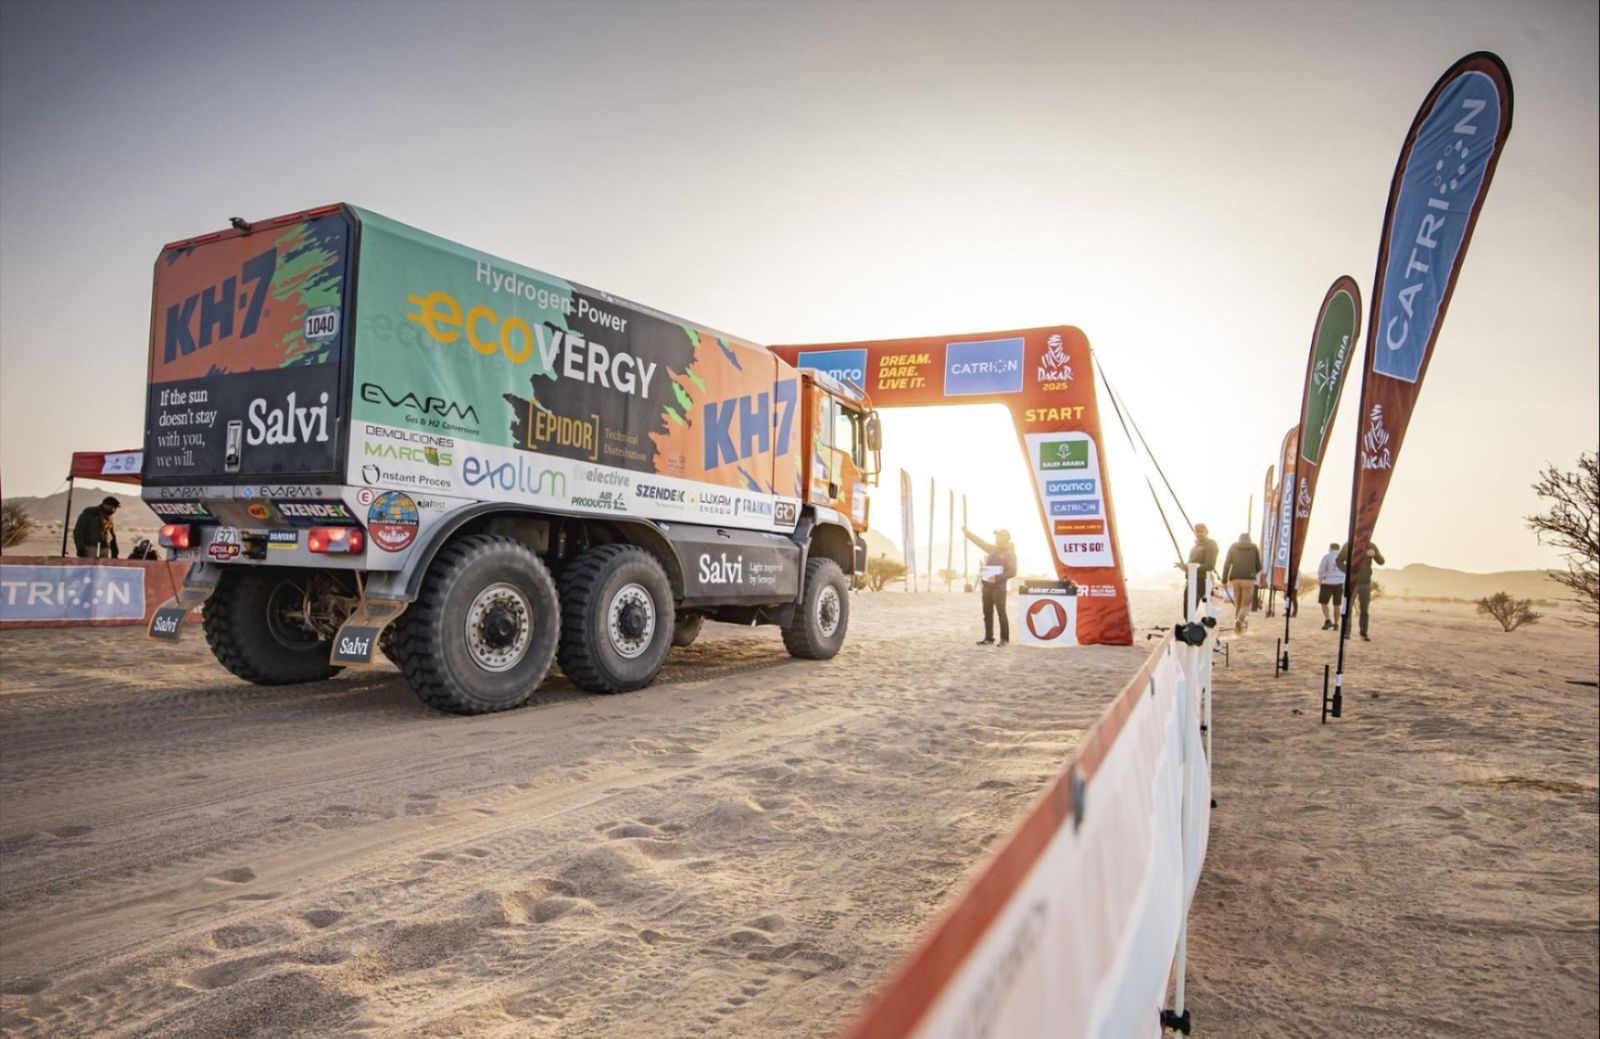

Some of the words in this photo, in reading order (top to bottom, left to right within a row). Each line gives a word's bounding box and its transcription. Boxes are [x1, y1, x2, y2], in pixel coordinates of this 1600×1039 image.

[1387, 97, 1488, 351] CATRION
[475, 260, 573, 315] Hydrogen
[578, 298, 628, 333] Power
[307, 314, 335, 336] 1040
[880, 352, 931, 367] DREAM.
[950, 359, 1018, 375] CATRION
[879, 365, 919, 378] DARE.
[1036, 366, 1074, 382] DAKAR
[878, 377, 908, 390] LIVE
[910, 376, 926, 388] IT.
[1042, 382, 1069, 391] 2025
[160, 390, 170, 407] If
[170, 389, 187, 404] the
[188, 389, 208, 403] sun
[159, 408, 194, 427] doesn't
[194, 410, 217, 427] stay
[246, 391, 329, 446] Salvi
[1025, 405, 1085, 422] START
[405, 414, 419, 425] Gas
[419, 416, 426, 425] &
[428, 418, 440, 428] H2
[442, 420, 480, 436] Conversions
[158, 431, 180, 447] with
[182, 432, 206, 451] you,
[365, 424, 455, 448] DEMOLICIONES
[157, 454, 173, 467] we
[174, 449, 195, 467] will.
[1061, 459, 1086, 467] ARABIA
[1360, 448, 1392, 471] DAKAR
[419, 475, 452, 488] Proces
[462, 455, 567, 498] exolum
[599, 490, 613, 500] AIR
[1048, 482, 1093, 493] aramco
[571, 496, 612, 510] PRODUCTS
[700, 492, 732, 506] LUXAM
[743, 498, 772, 516] FRAIKIN
[1053, 503, 1096, 512] CATRION
[1277, 480, 1292, 561] aramco
[1063, 543, 1088, 553] LET'S
[1089, 542, 1105, 552] GO!
[698, 552, 744, 585] Salvi
[750, 561, 763, 574] Light
[749, 574, 757, 586] by
[1028, 586, 1067, 594] dakar.com
[153, 615, 177, 633] Salvi
[338, 637, 369, 656] Salvi
